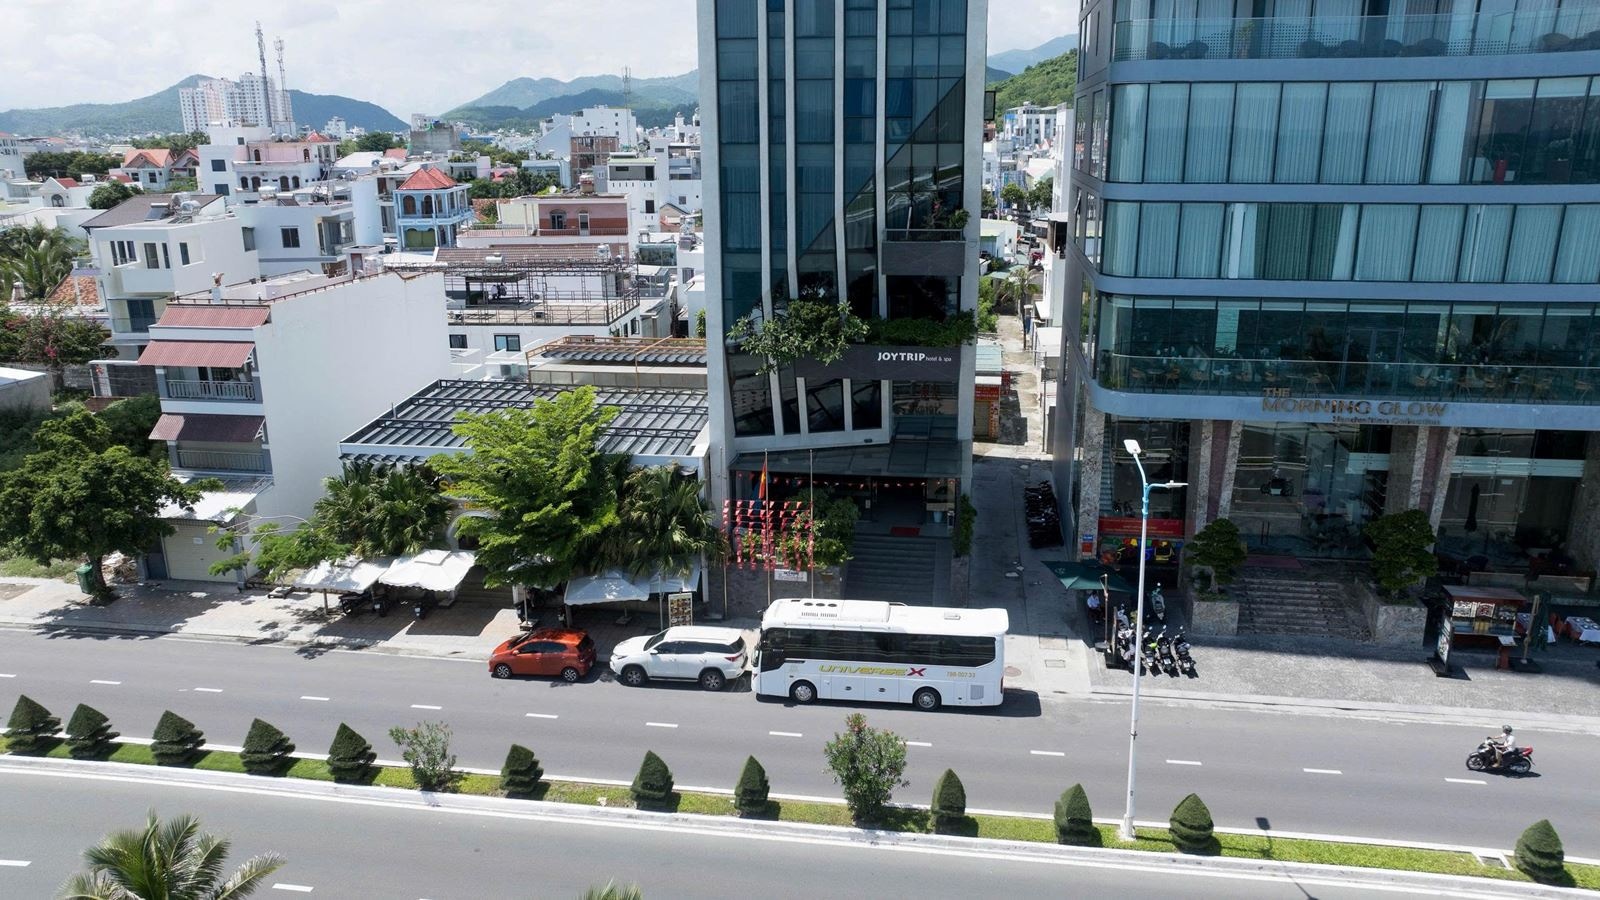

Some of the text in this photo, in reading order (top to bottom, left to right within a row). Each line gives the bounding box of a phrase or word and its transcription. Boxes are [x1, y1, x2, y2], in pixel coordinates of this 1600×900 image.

[877, 352, 925, 361] JOYTRIP
[1263, 388, 1290, 397] THE
[1262, 397, 1448, 417] MORNING GLOW
